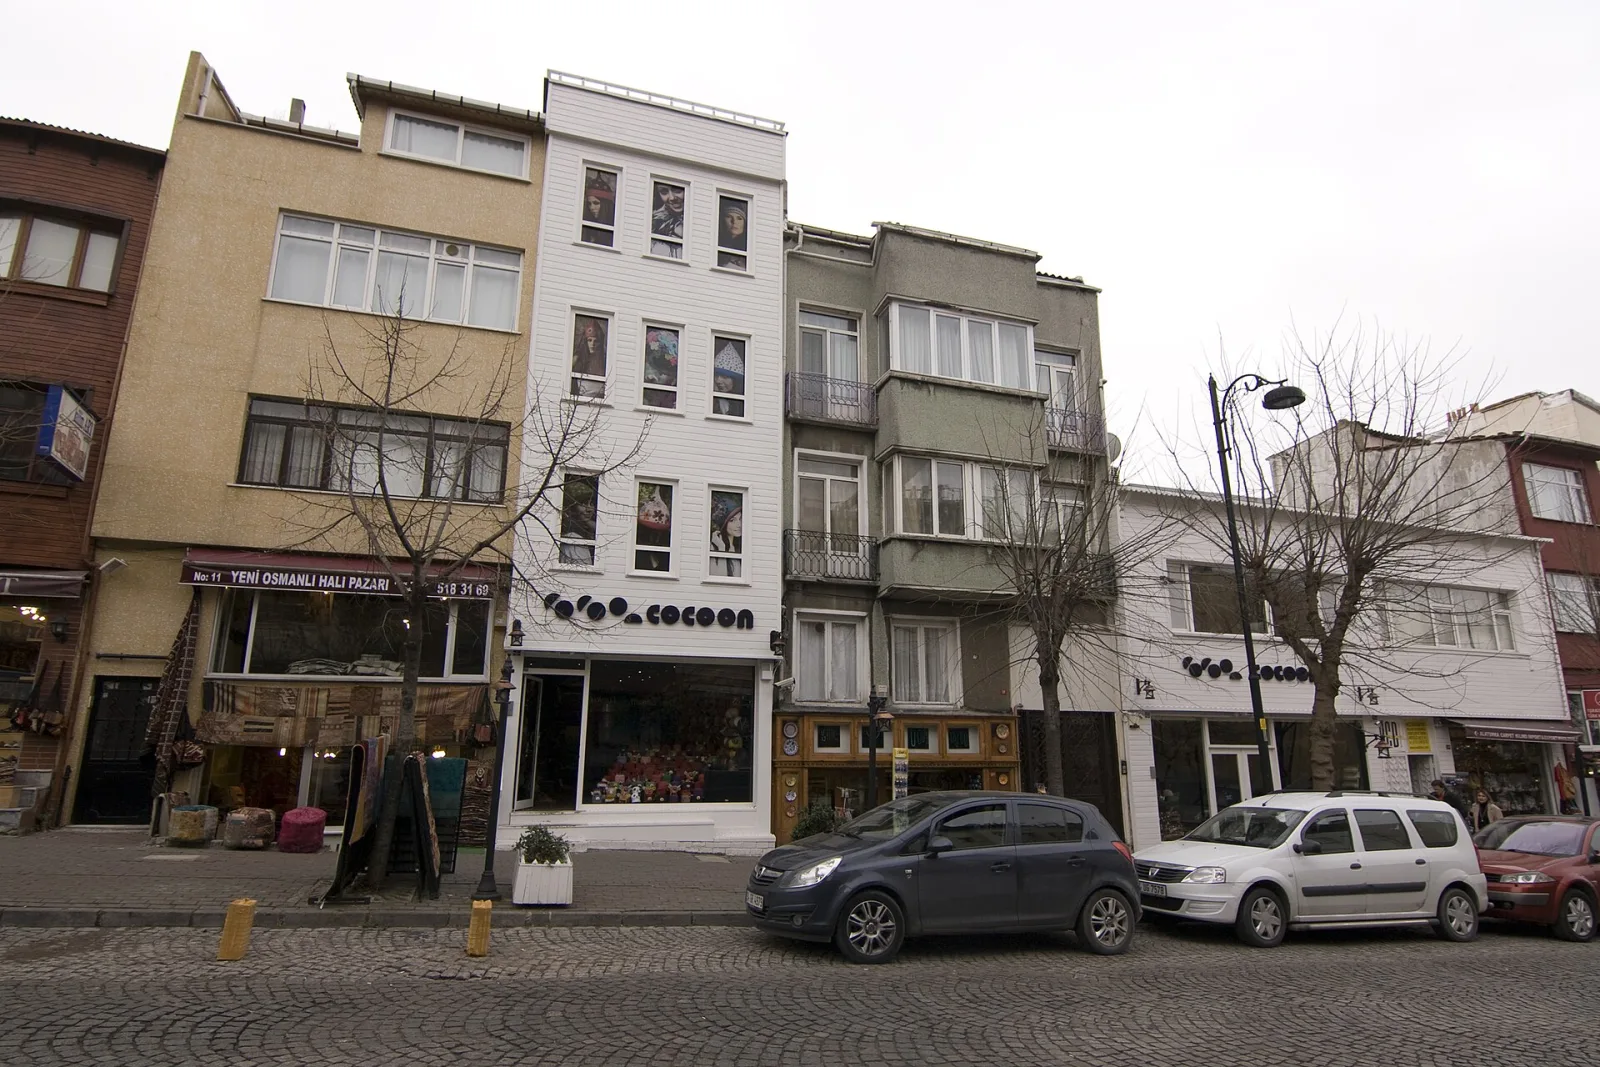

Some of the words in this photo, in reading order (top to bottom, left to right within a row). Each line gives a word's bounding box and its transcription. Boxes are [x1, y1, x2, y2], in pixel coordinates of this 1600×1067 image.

[194, 571, 209, 582] No:
[211, 573, 221, 582] 11
[231, 569, 260, 584] YENİ
[262, 572, 316, 587] OSMANLI
[318, 575, 346, 589] HALI
[348, 576, 389, 591] PAZARI
[437, 582, 456, 595] 518
[460, 583, 473, 595] 31
[475, 584, 489, 596] 69
